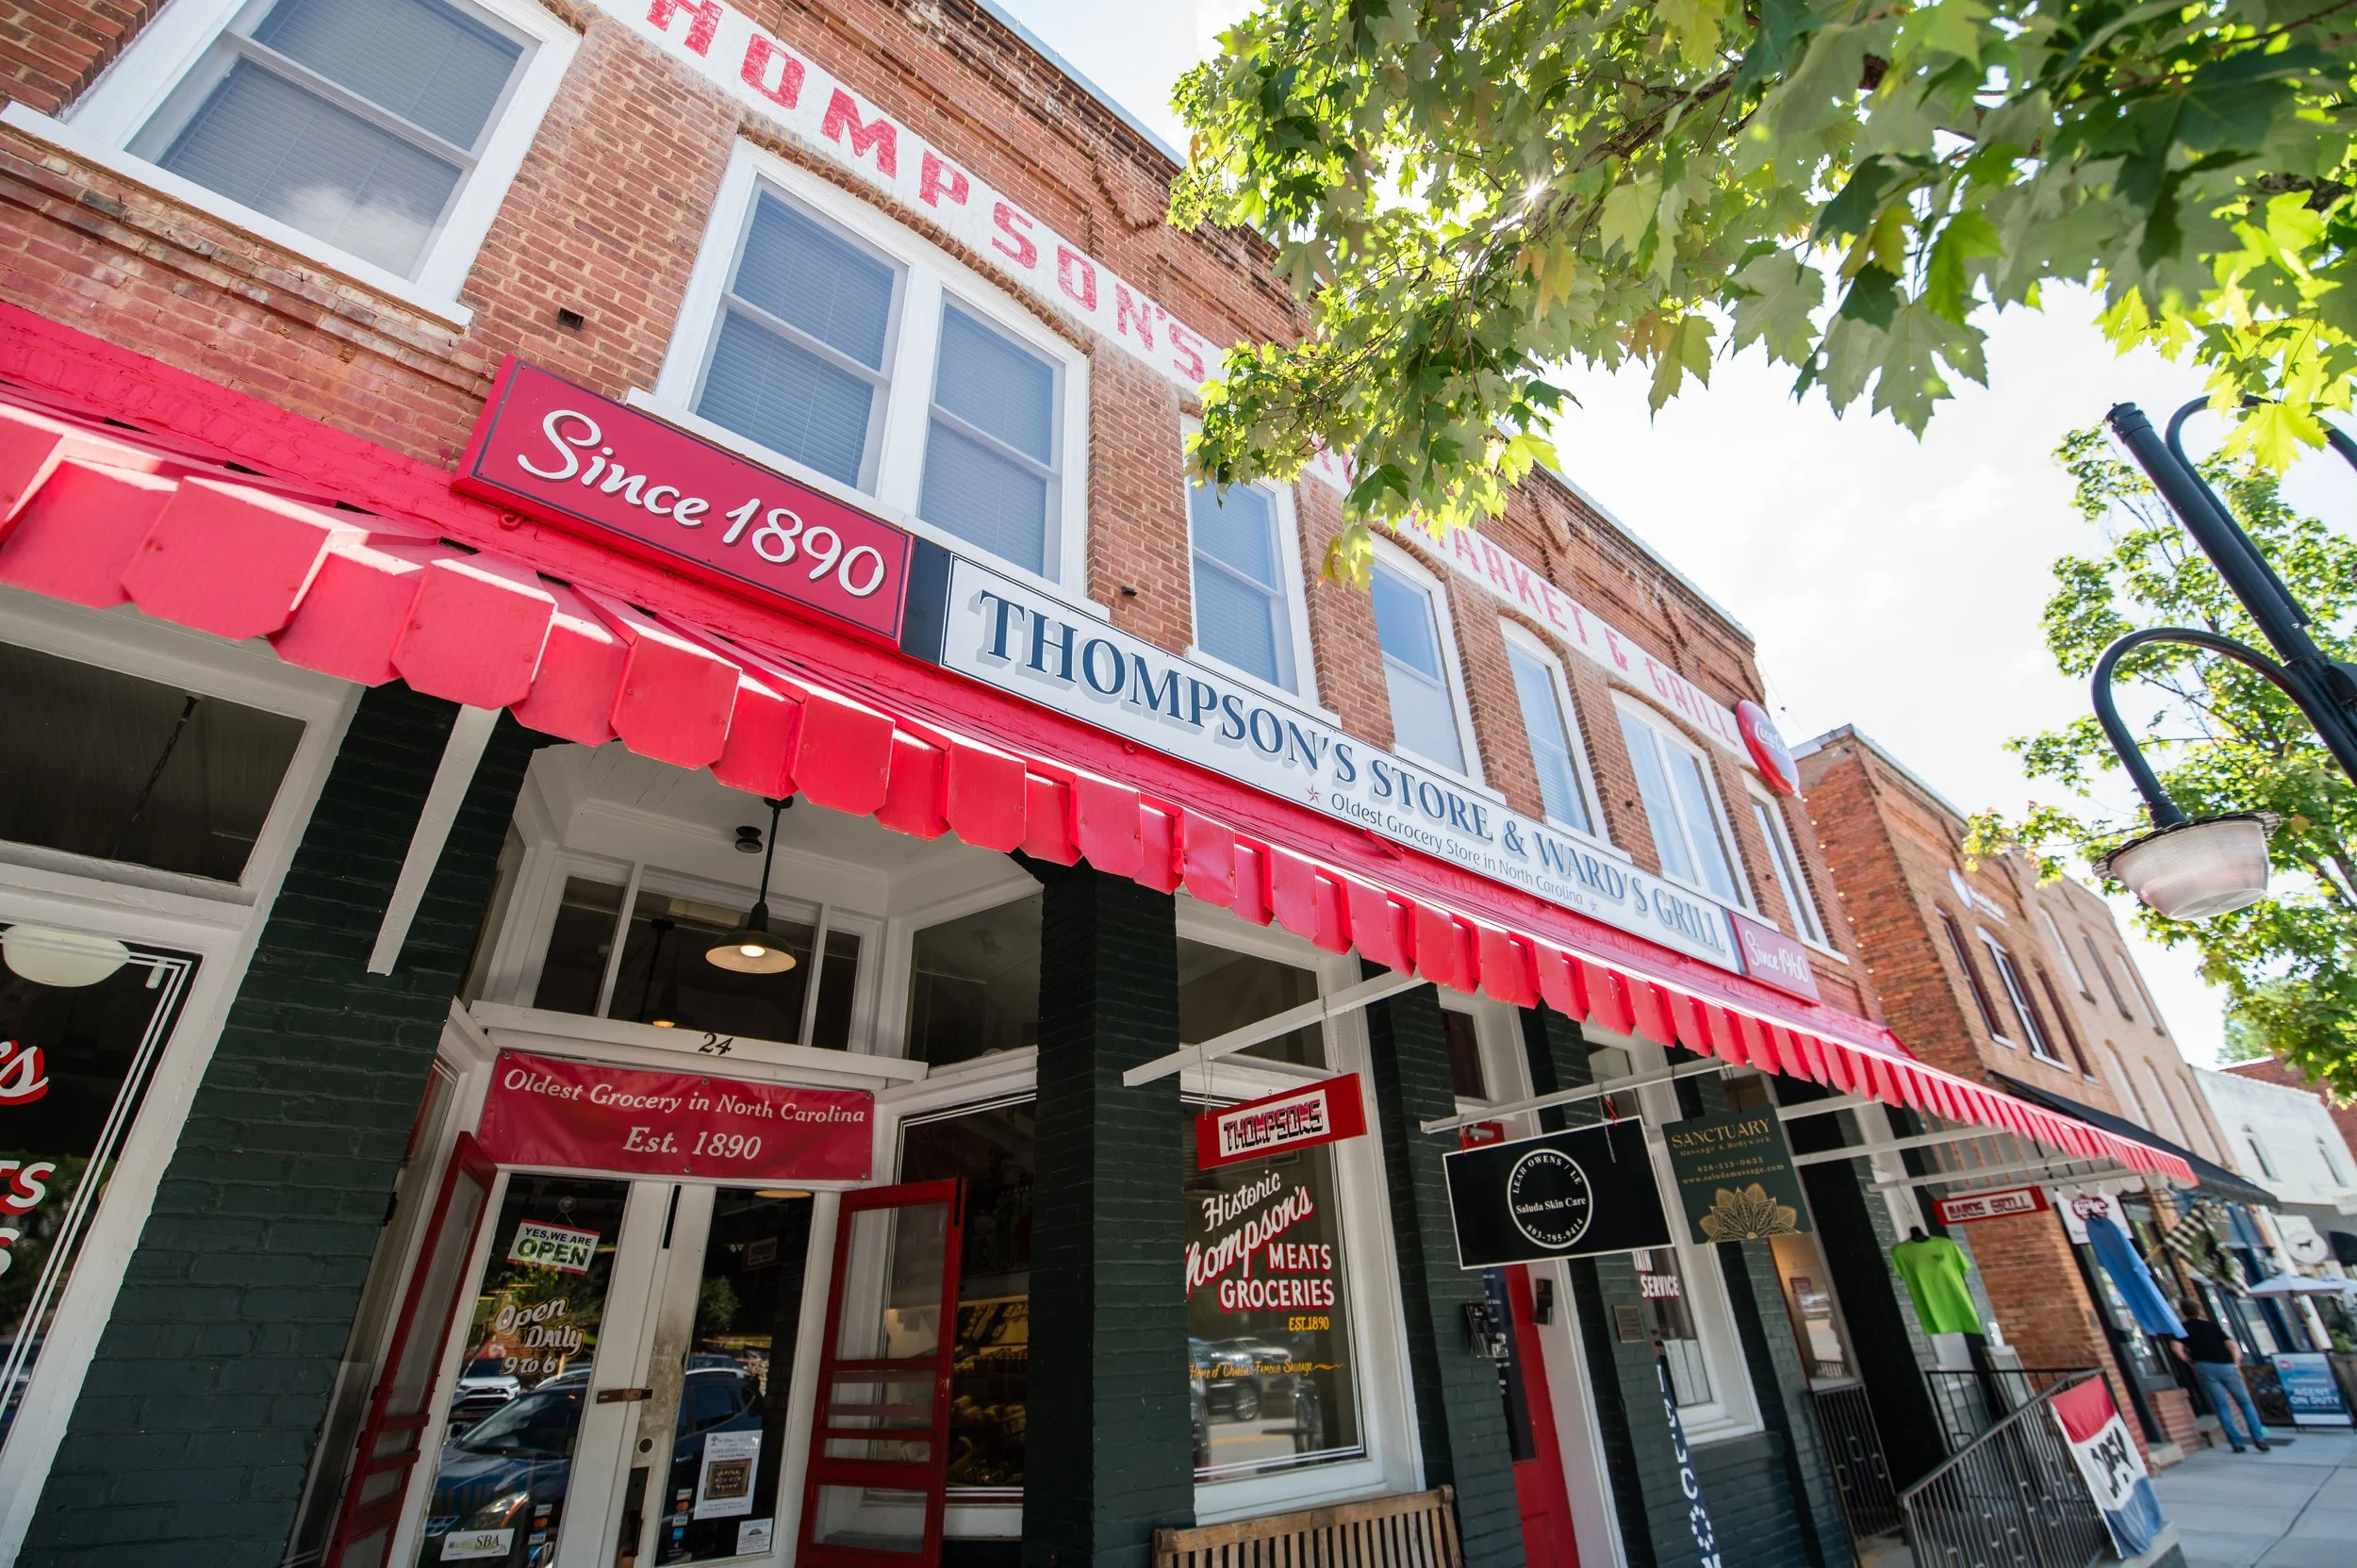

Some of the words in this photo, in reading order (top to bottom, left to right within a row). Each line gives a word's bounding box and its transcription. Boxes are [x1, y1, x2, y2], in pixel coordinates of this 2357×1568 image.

[517, 409, 710, 526] Since
[721, 498, 885, 597] 1890
[1644, 656, 1739, 748] GRILL
[978, 589, 1358, 784] THOMPSON'S
[1371, 758, 1494, 843] STORE
[1504, 819, 1529, 858] &
[1534, 831, 1649, 914] WARD'S
[1654, 887, 1726, 953] GRILL
[1331, 792, 1383, 828] Oldest
[1387, 815, 1442, 853] Grocery
[1446, 838, 1480, 866] Store
[1483, 852, 1496, 871] in
[1498, 859, 1534, 886] North
[1535, 876, 1584, 906] Carolina
[1745, 930, 1780, 972] Since
[697, 1032, 734, 1056] 24
[503, 1067, 584, 1102] Oldest
[589, 1082, 684, 1114] Grocery
[687, 1091, 710, 1113] in
[715, 1094, 774, 1120] North
[779, 1102, 865, 1124] Carolina
[1223, 1098, 1324, 1152] THOMPSONS
[1671, 1118, 1771, 1148] SANCTUARY
[622, 1125, 678, 1155] Est.
[691, 1131, 763, 1161] 1890
[1679, 1146, 1716, 1157] Massage
[1726, 1136, 1772, 1149] Bodywork
[1512, 1165, 1527, 1195] LEAH
[1527, 1155, 1562, 1167] OWENS
[1569, 1170, 1582, 1185] LE
[1202, 1169, 1281, 1232] Historic
[1515, 1202, 1544, 1214] Saluda
[1544, 1199, 1564, 1211] Skin
[1565, 1197, 1587, 1208] Care
[569, 1235, 593, 1247] ARE
[1185, 1185, 1313, 1295] hompson's
[1525, 1217, 1584, 1243] 803-795-9414
[517, 1238, 589, 1267] OPEN
[1269, 1243, 1332, 1271] MEATS
[1220, 1279, 1335, 1309] GROCERIES
[1640, 1275, 1680, 1298] SERVICE
[495, 1298, 567, 1336] Open
[503, 1356, 519, 1375] 9
[542, 1356, 558, 1374] 6
[475, 1533, 500, 1548] SBA
